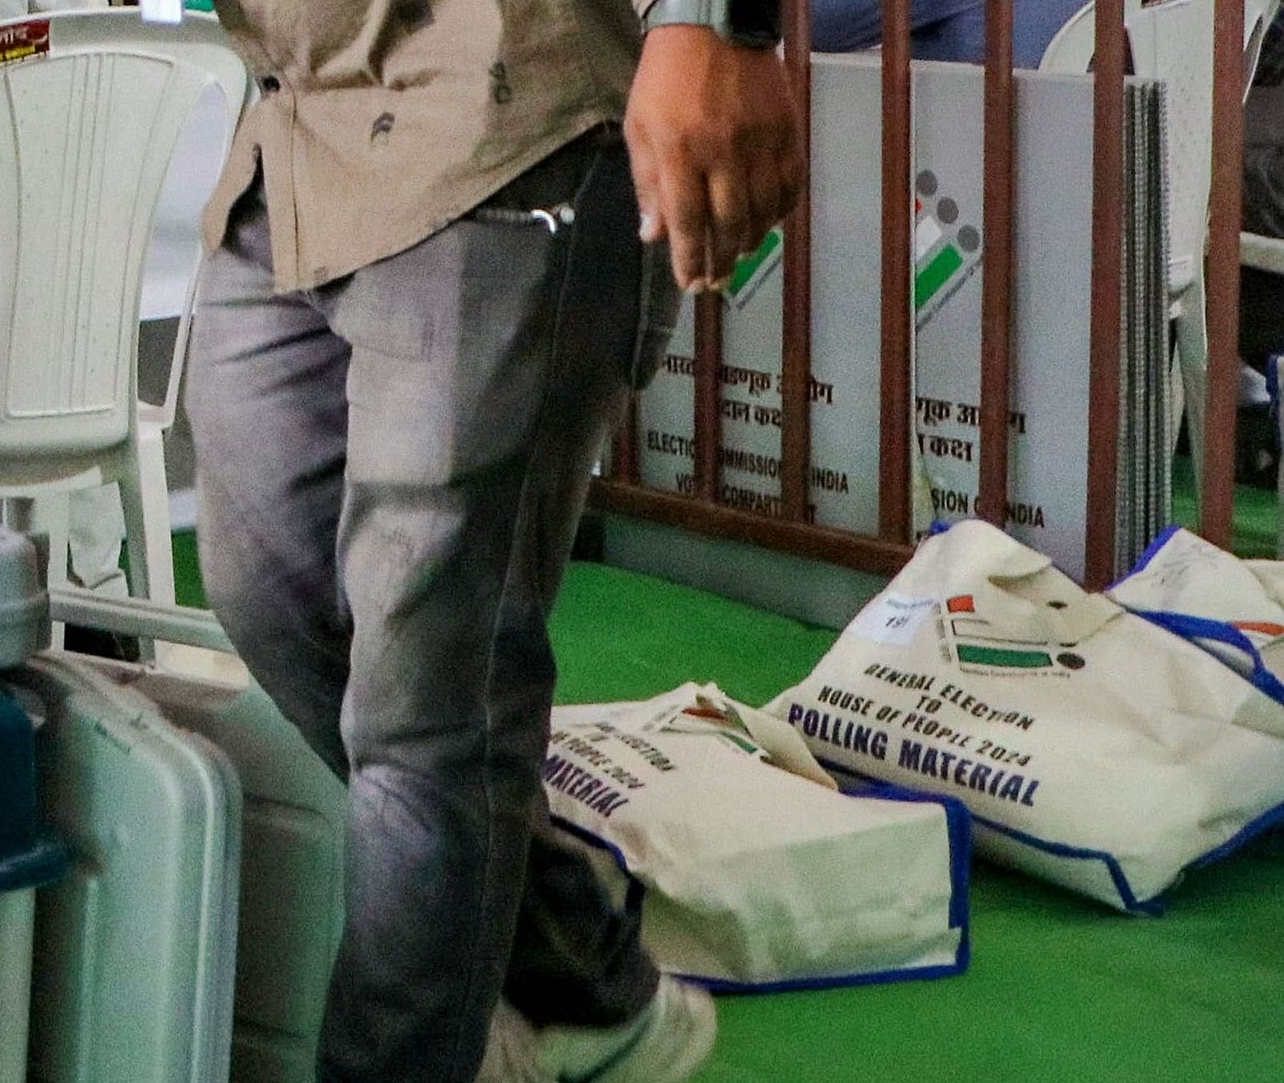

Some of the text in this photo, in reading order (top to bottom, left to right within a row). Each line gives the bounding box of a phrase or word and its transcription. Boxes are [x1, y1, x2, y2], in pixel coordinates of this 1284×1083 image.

[818, 685, 1034, 767] HOUSE OF PEOPLE 2024
[916, 695, 942, 715] TO
[939, 682, 1035, 731] ELECTION
[789, 702, 1040, 807] POLLING MATERIAL
